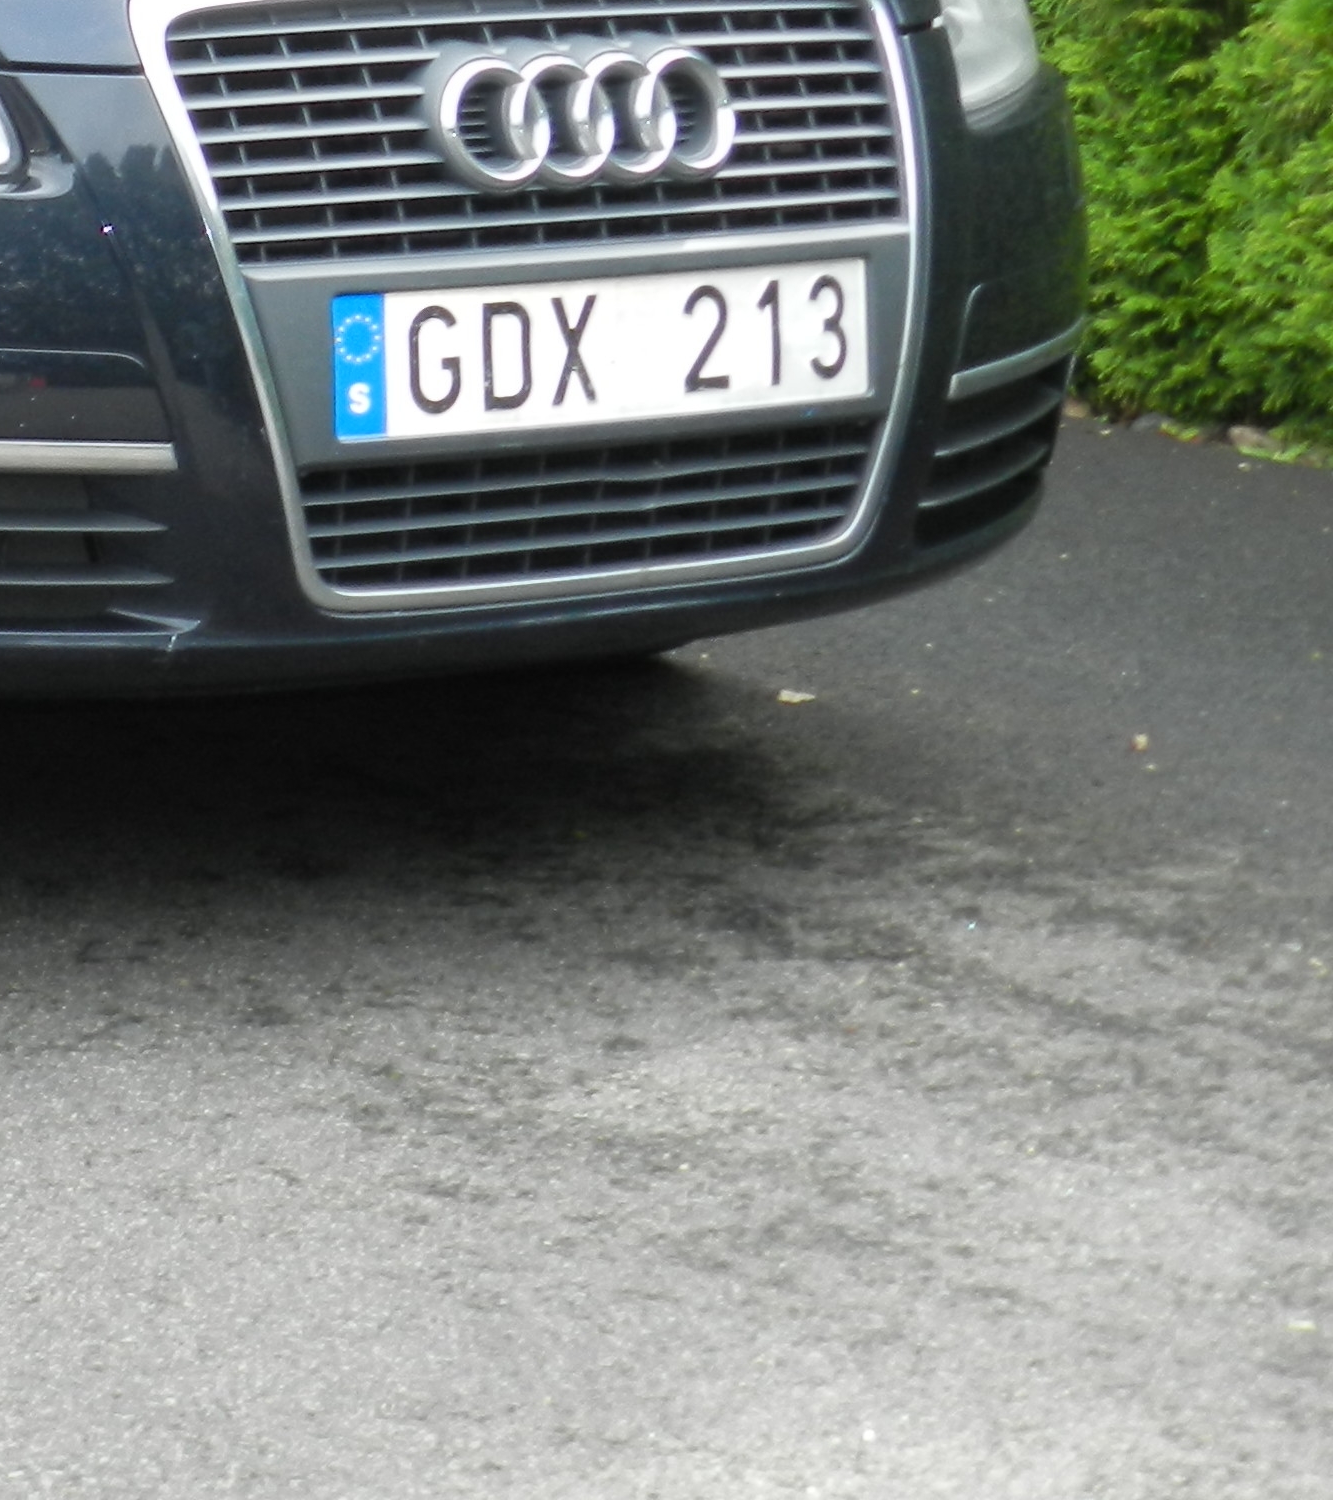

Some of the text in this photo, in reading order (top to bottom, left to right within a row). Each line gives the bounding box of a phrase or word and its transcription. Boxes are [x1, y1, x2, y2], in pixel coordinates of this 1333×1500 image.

[408, 274, 848, 414] GDX 213
[348, 382, 371, 414] S
